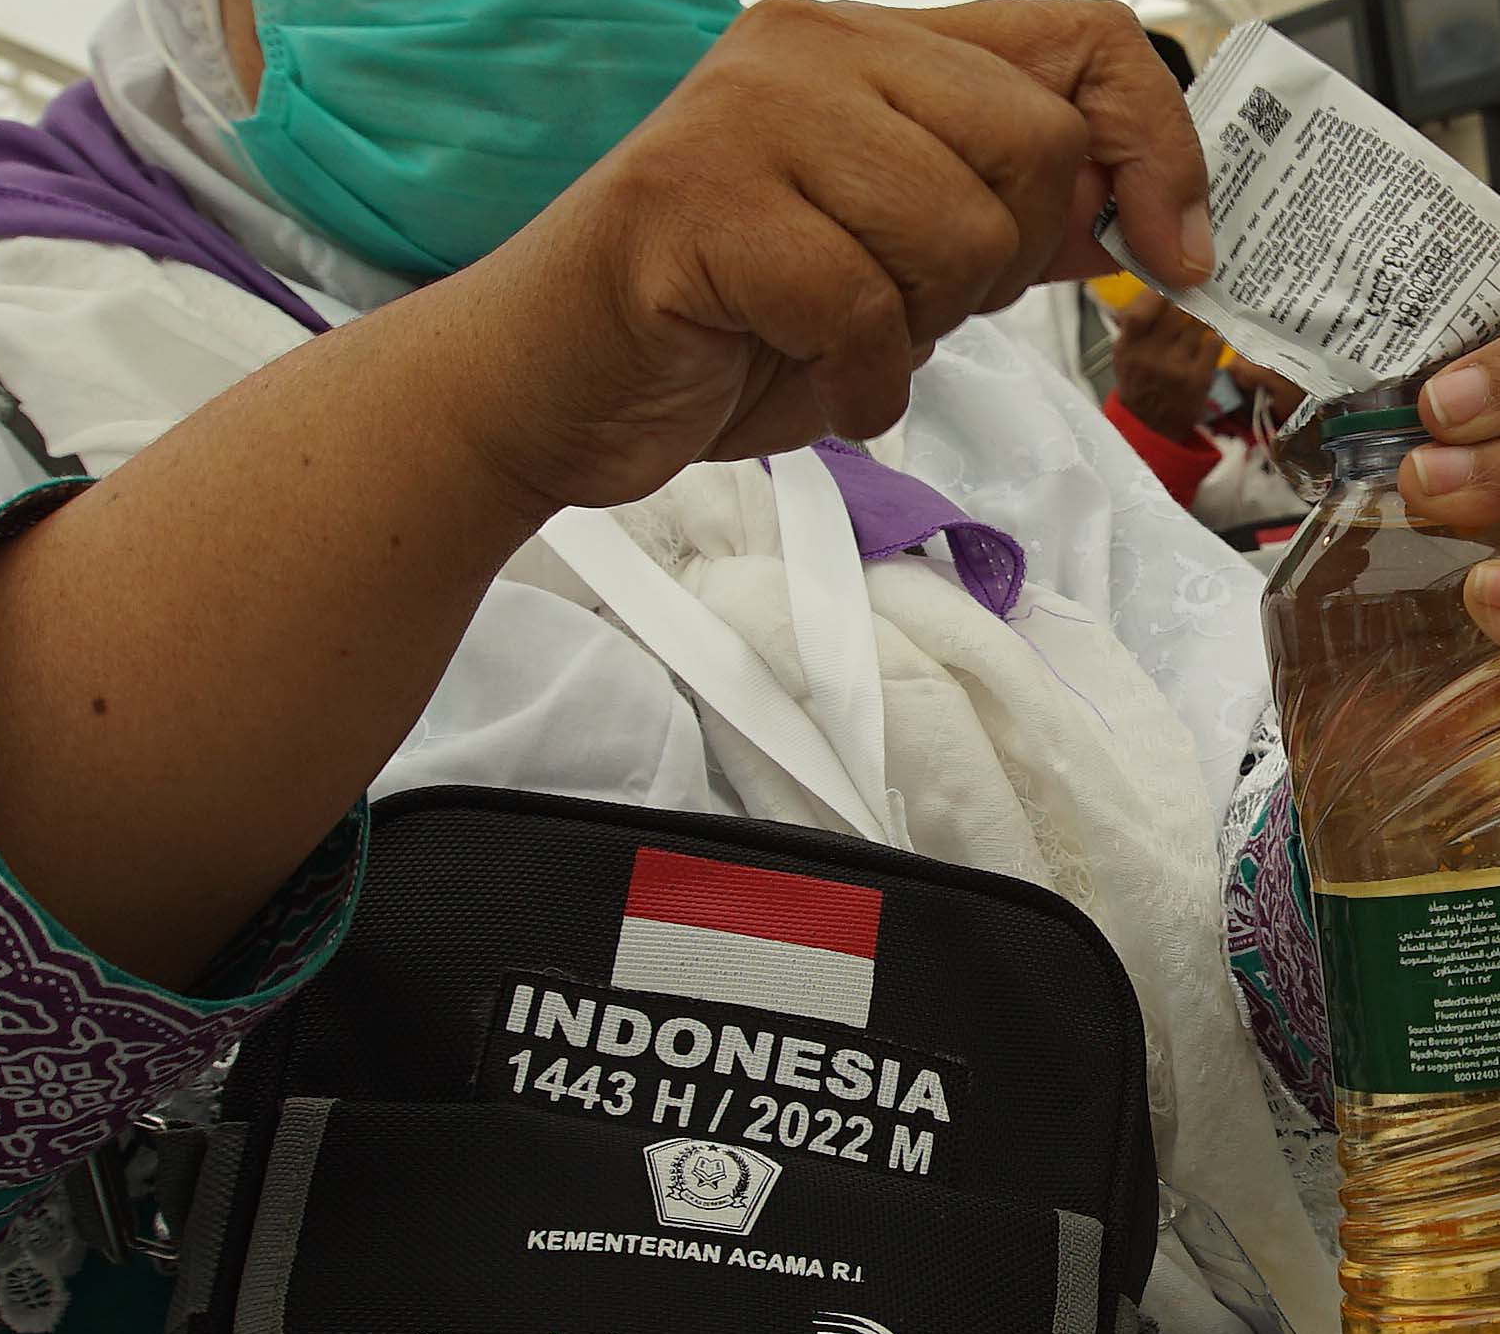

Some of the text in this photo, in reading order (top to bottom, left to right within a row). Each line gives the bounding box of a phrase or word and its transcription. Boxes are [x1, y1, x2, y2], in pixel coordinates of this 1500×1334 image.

[1434, 1004, 1488, 1022] Fluoridated
[505, 984, 952, 1123] INDONESIA
[1408, 1035, 1428, 1048] Pure
[1427, 1032, 1473, 1049] Beverages
[1410, 1061, 1425, 1072] For
[1426, 1057, 1480, 1075] suggestions
[1481, 1056, 1499, 1067] and
[508, 1051, 935, 1176] 1443 H / 2022 M
[527, 1228, 722, 1264] KEMENTERIAN
[728, 1247, 826, 1279] AGAMA
